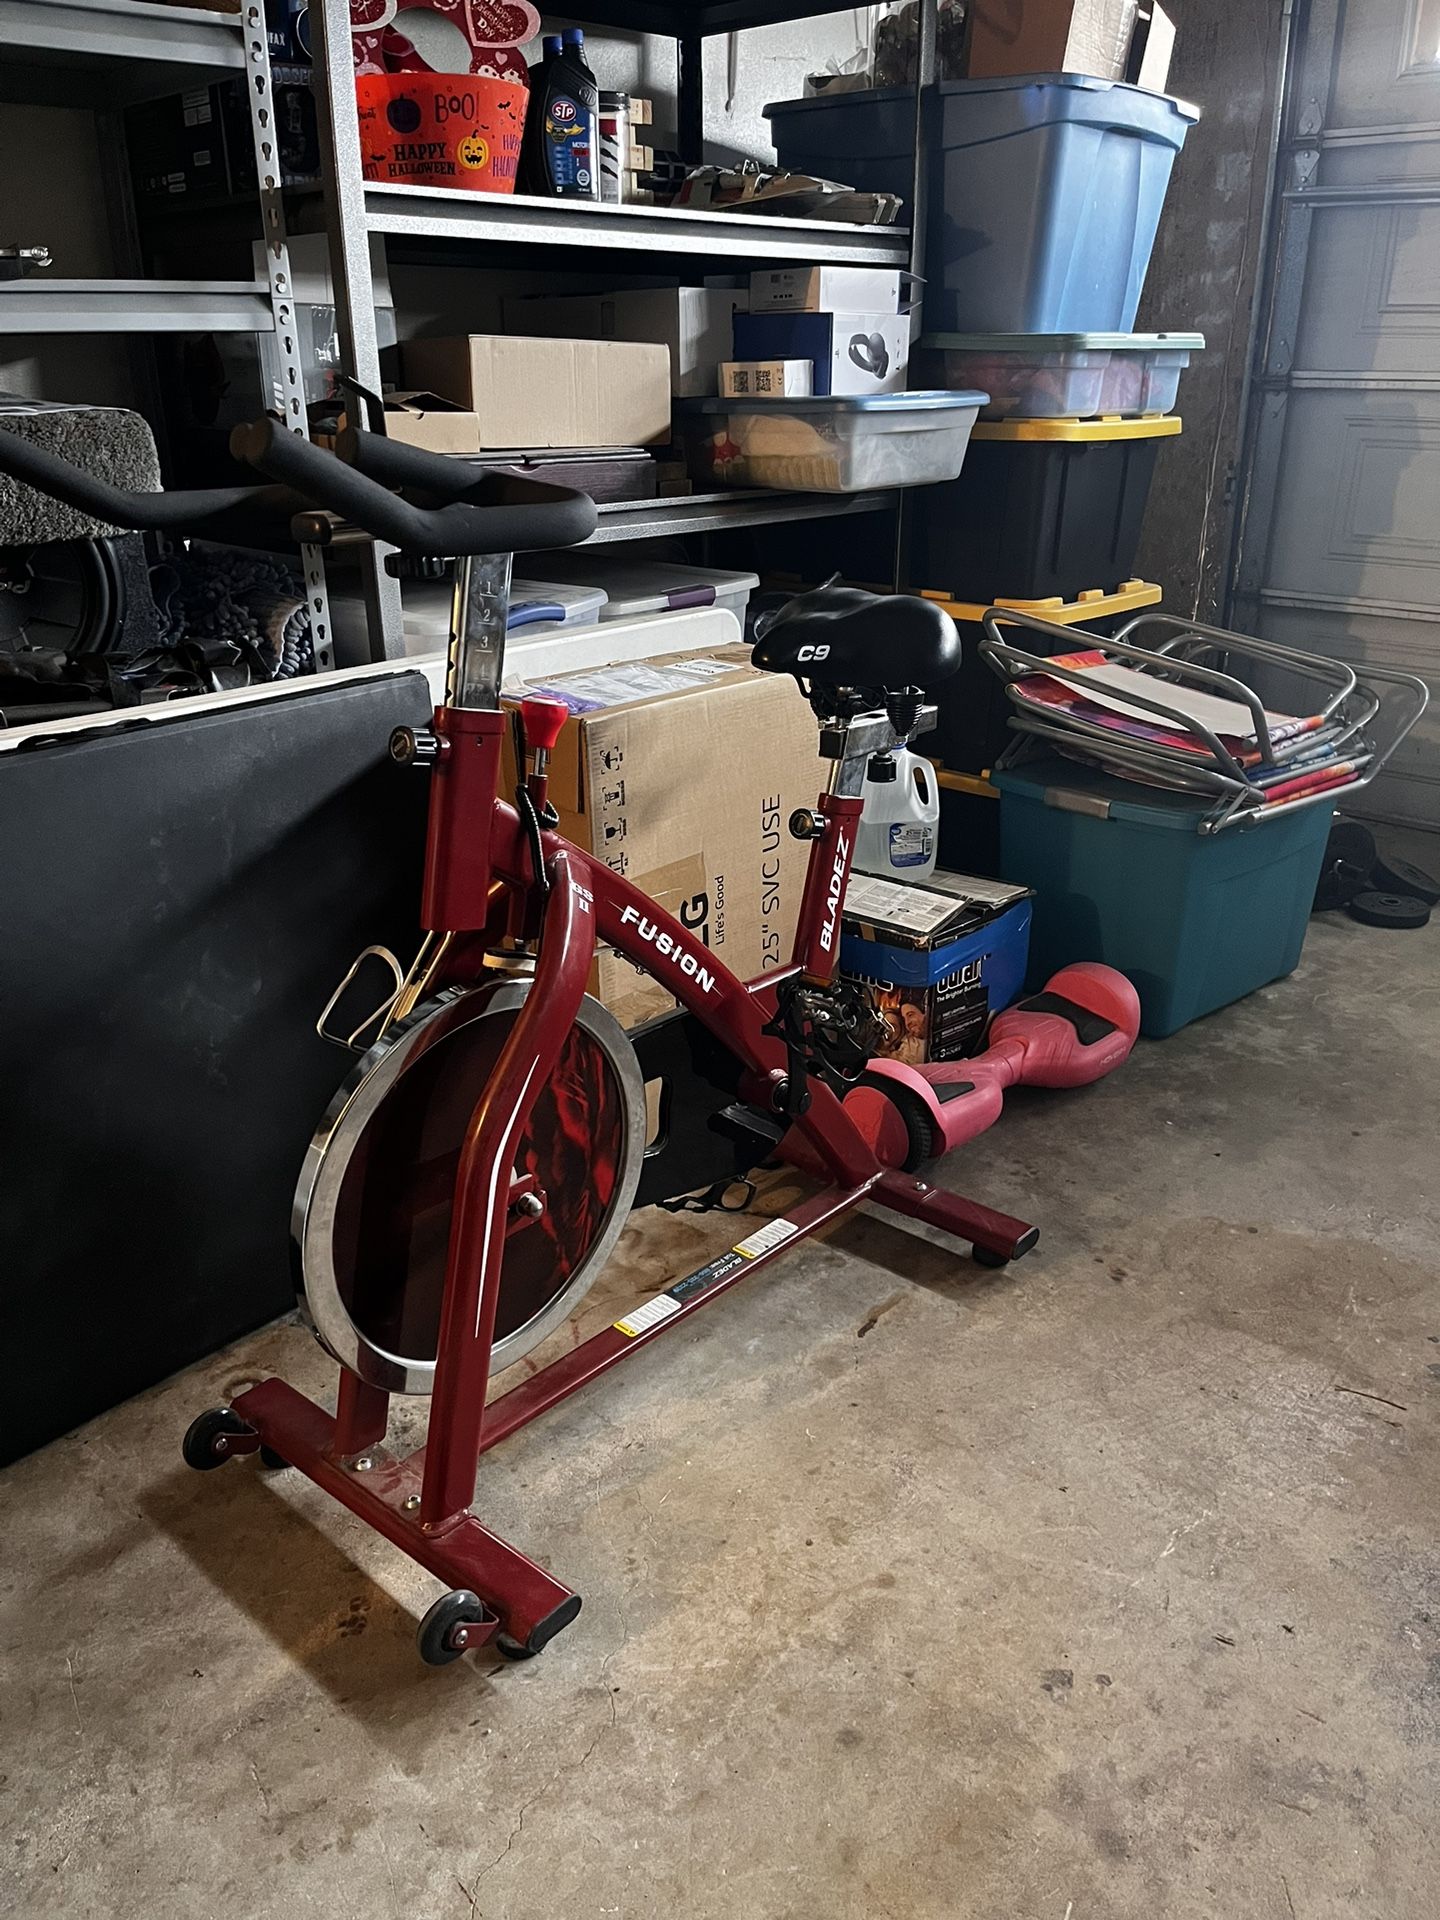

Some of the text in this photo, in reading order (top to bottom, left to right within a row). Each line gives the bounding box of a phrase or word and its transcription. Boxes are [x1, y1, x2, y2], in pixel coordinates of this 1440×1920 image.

[477, 17, 496, 38] Day
[434, 91, 480, 124] BOO!
[555, 103, 574, 118] STP
[393, 142, 448, 161] HAPPY
[388, 161, 456, 177] HALLOWEEN
[485, 581, 493, 594] 1
[483, 609, 491, 621] 2
[481, 636, 489, 648] 3
[797, 645, 831, 662] C9
[762, 794, 780, 969] 25" SVC USE
[820, 831, 849, 952] BLADEZ
[714, 875, 725, 945] Life's Good
[620, 905, 716, 993] FUSION
[712, 1257, 743, 1280] BLADEZ
